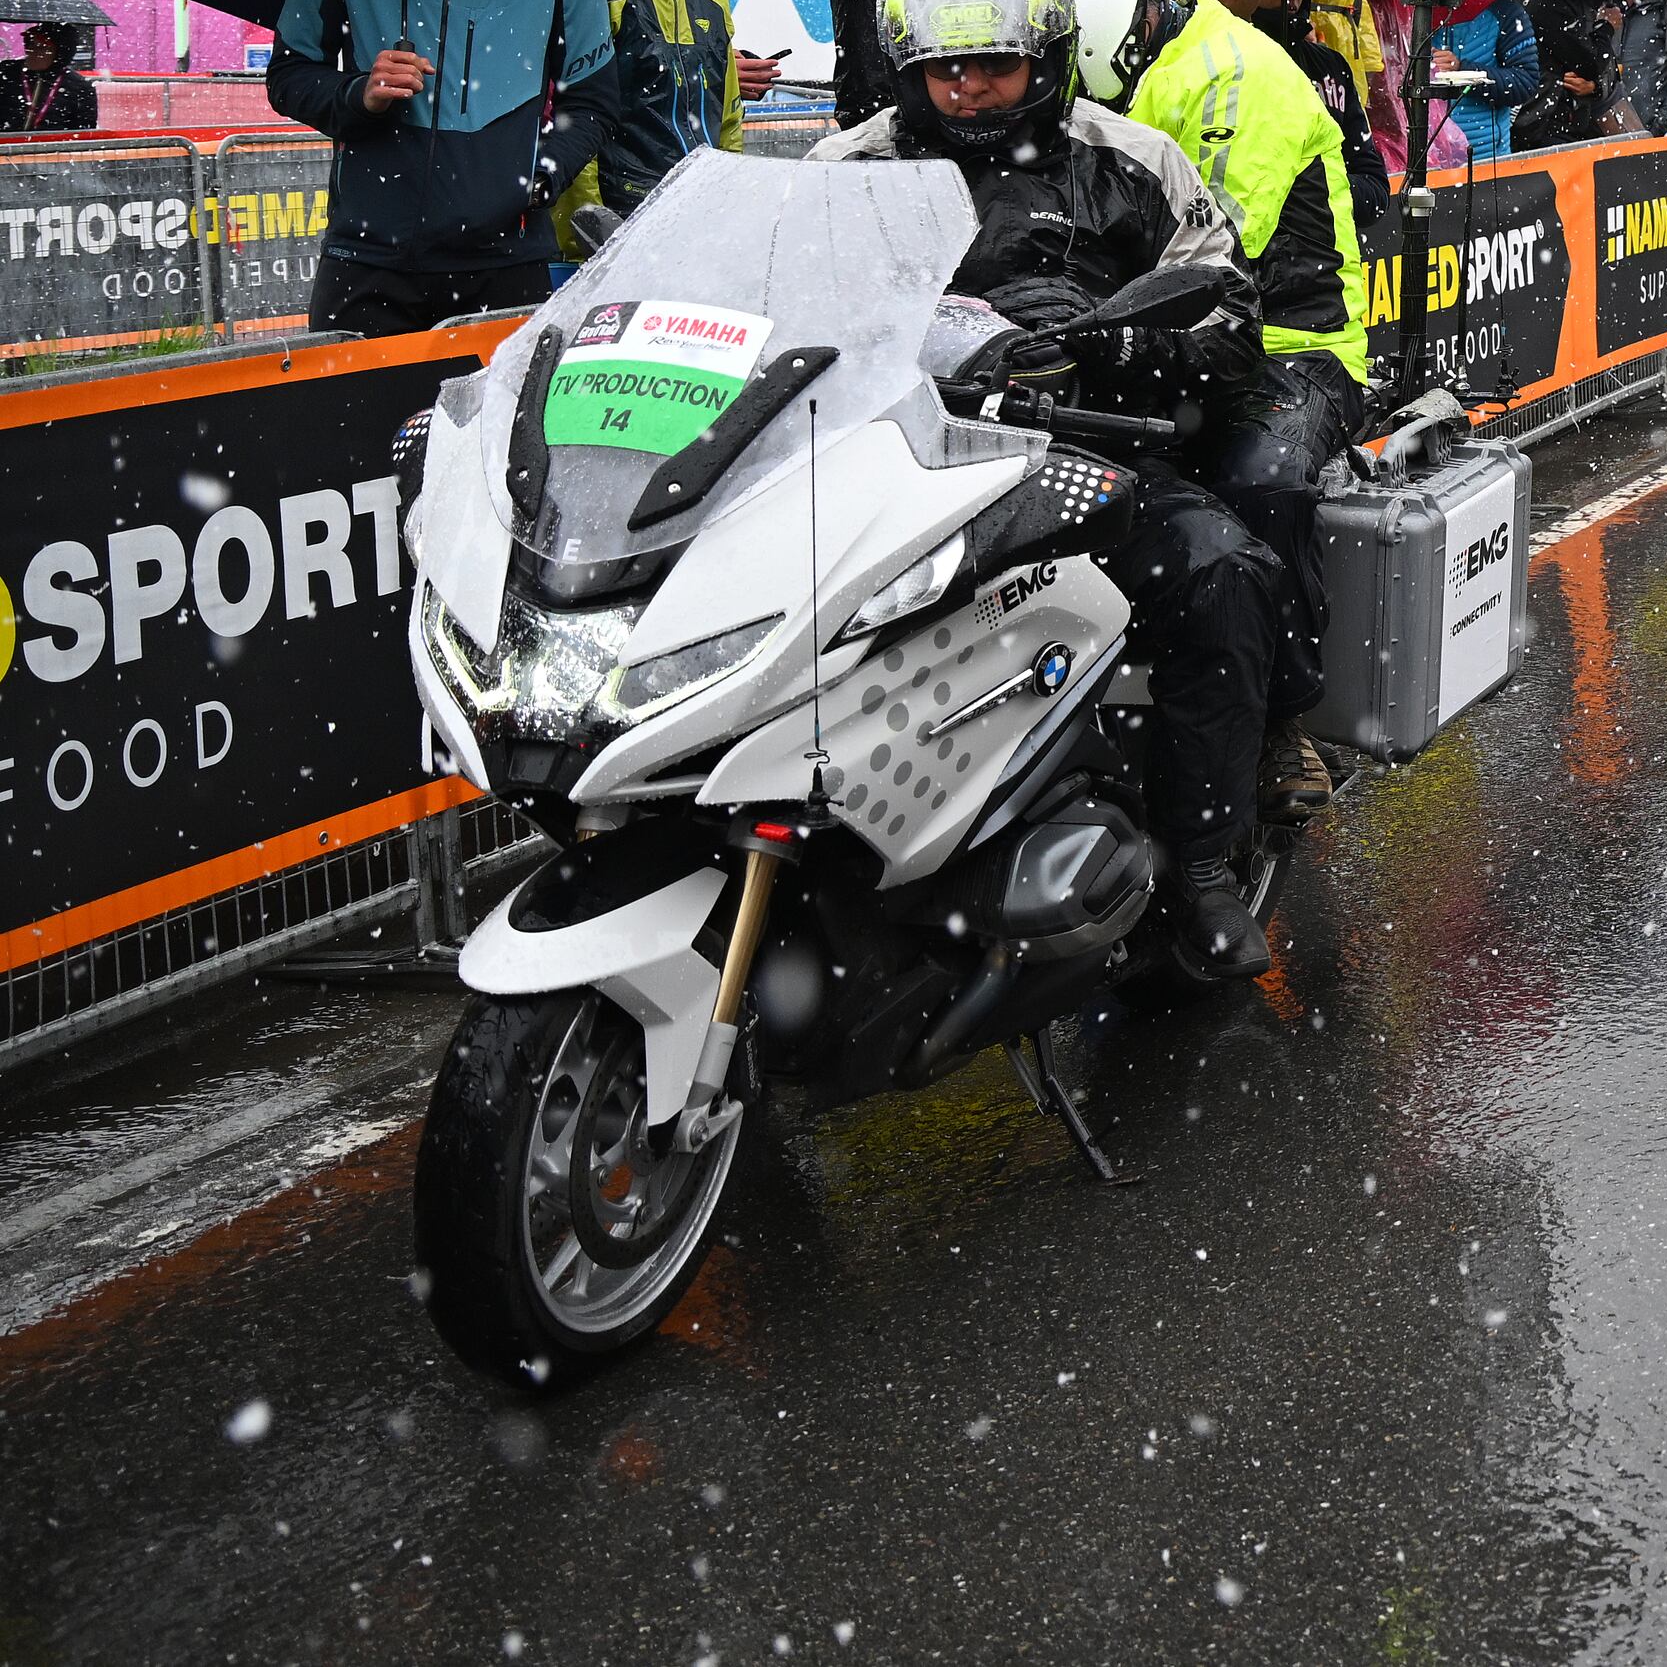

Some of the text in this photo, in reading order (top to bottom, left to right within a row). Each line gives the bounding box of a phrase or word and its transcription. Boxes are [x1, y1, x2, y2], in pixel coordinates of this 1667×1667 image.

[665, 316, 748, 346] YAMAHA
[552, 373, 728, 411] TV PRODUCTION
[600, 407, 632, 432] 14
[561, 538, 582, 562] E
[1466, 521, 1509, 582] EMG
[999, 560, 1058, 614] EMG
[1452, 590, 1503, 637] CONNECTIVITY
